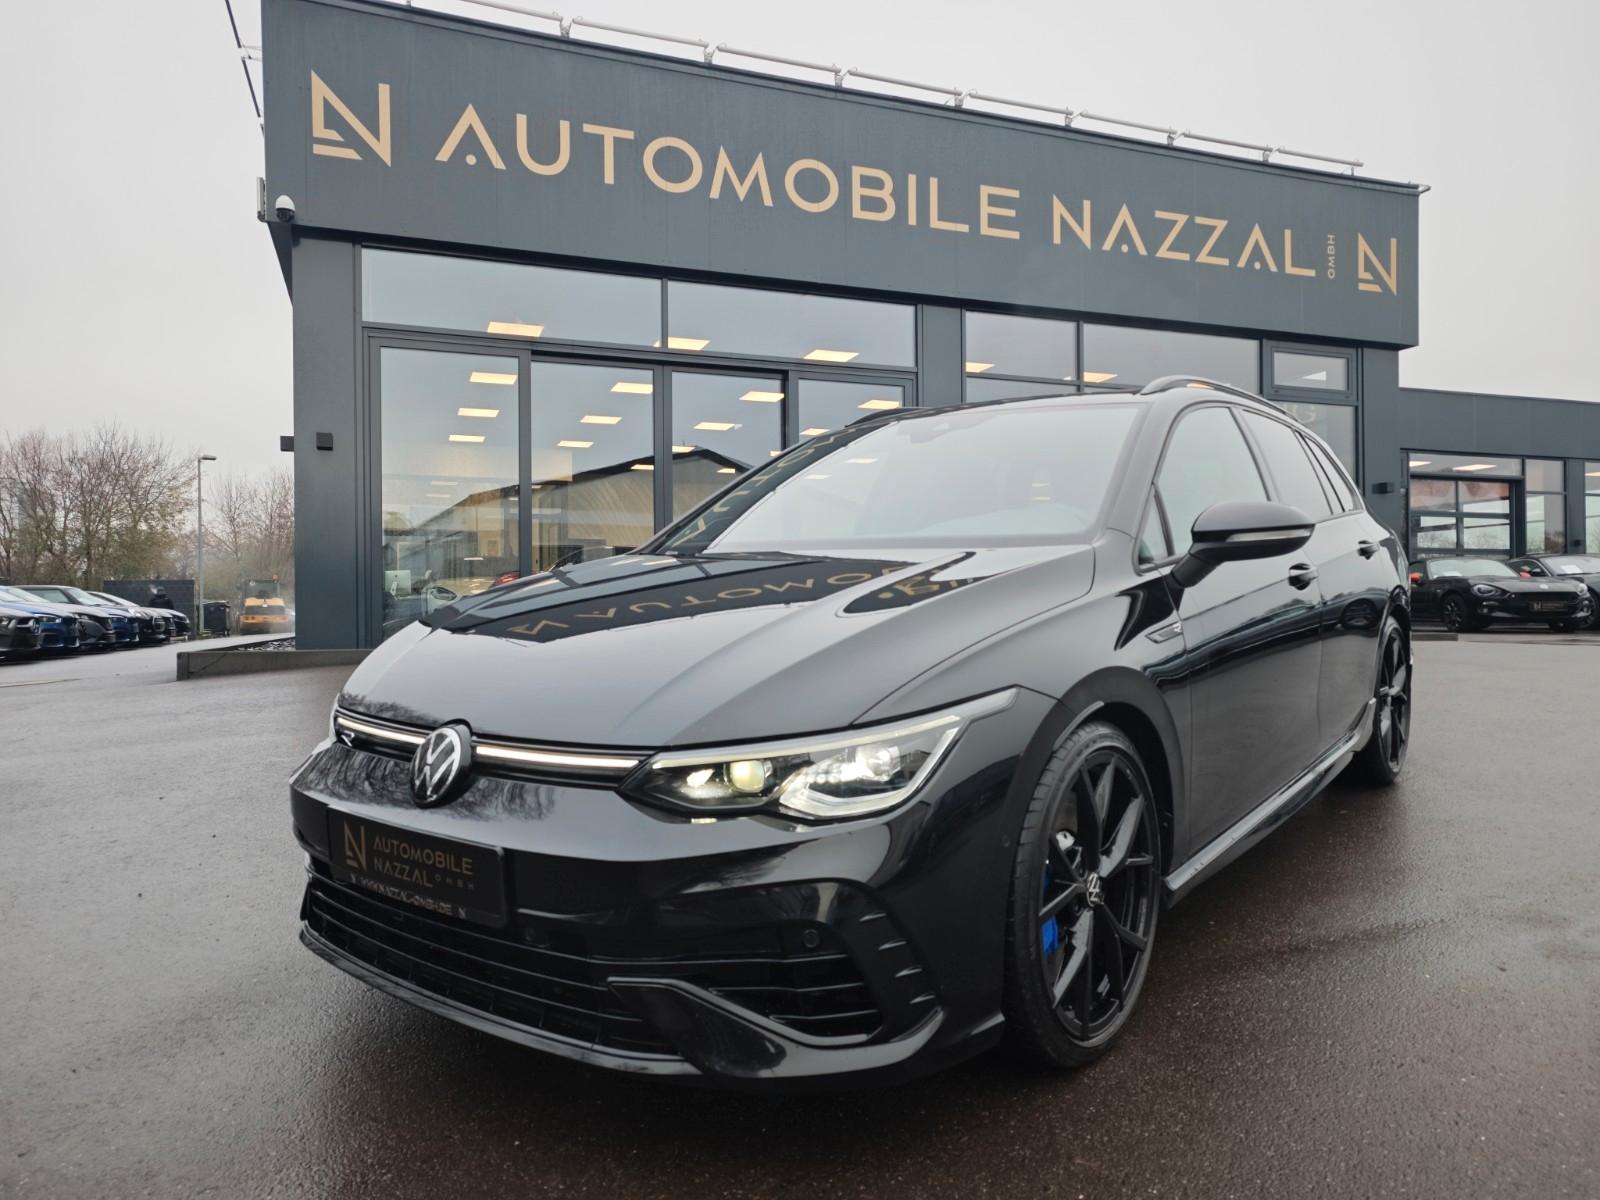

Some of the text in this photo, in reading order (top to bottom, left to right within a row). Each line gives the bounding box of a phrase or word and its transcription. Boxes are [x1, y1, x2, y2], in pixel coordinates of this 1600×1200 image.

[435, 103, 1020, 240] AUTOMOBILE
[1053, 194, 1316, 278] NAZZAL
[373, 836, 474, 876] AUTOMOBILE
[373, 857, 434, 888] NAZZAL
